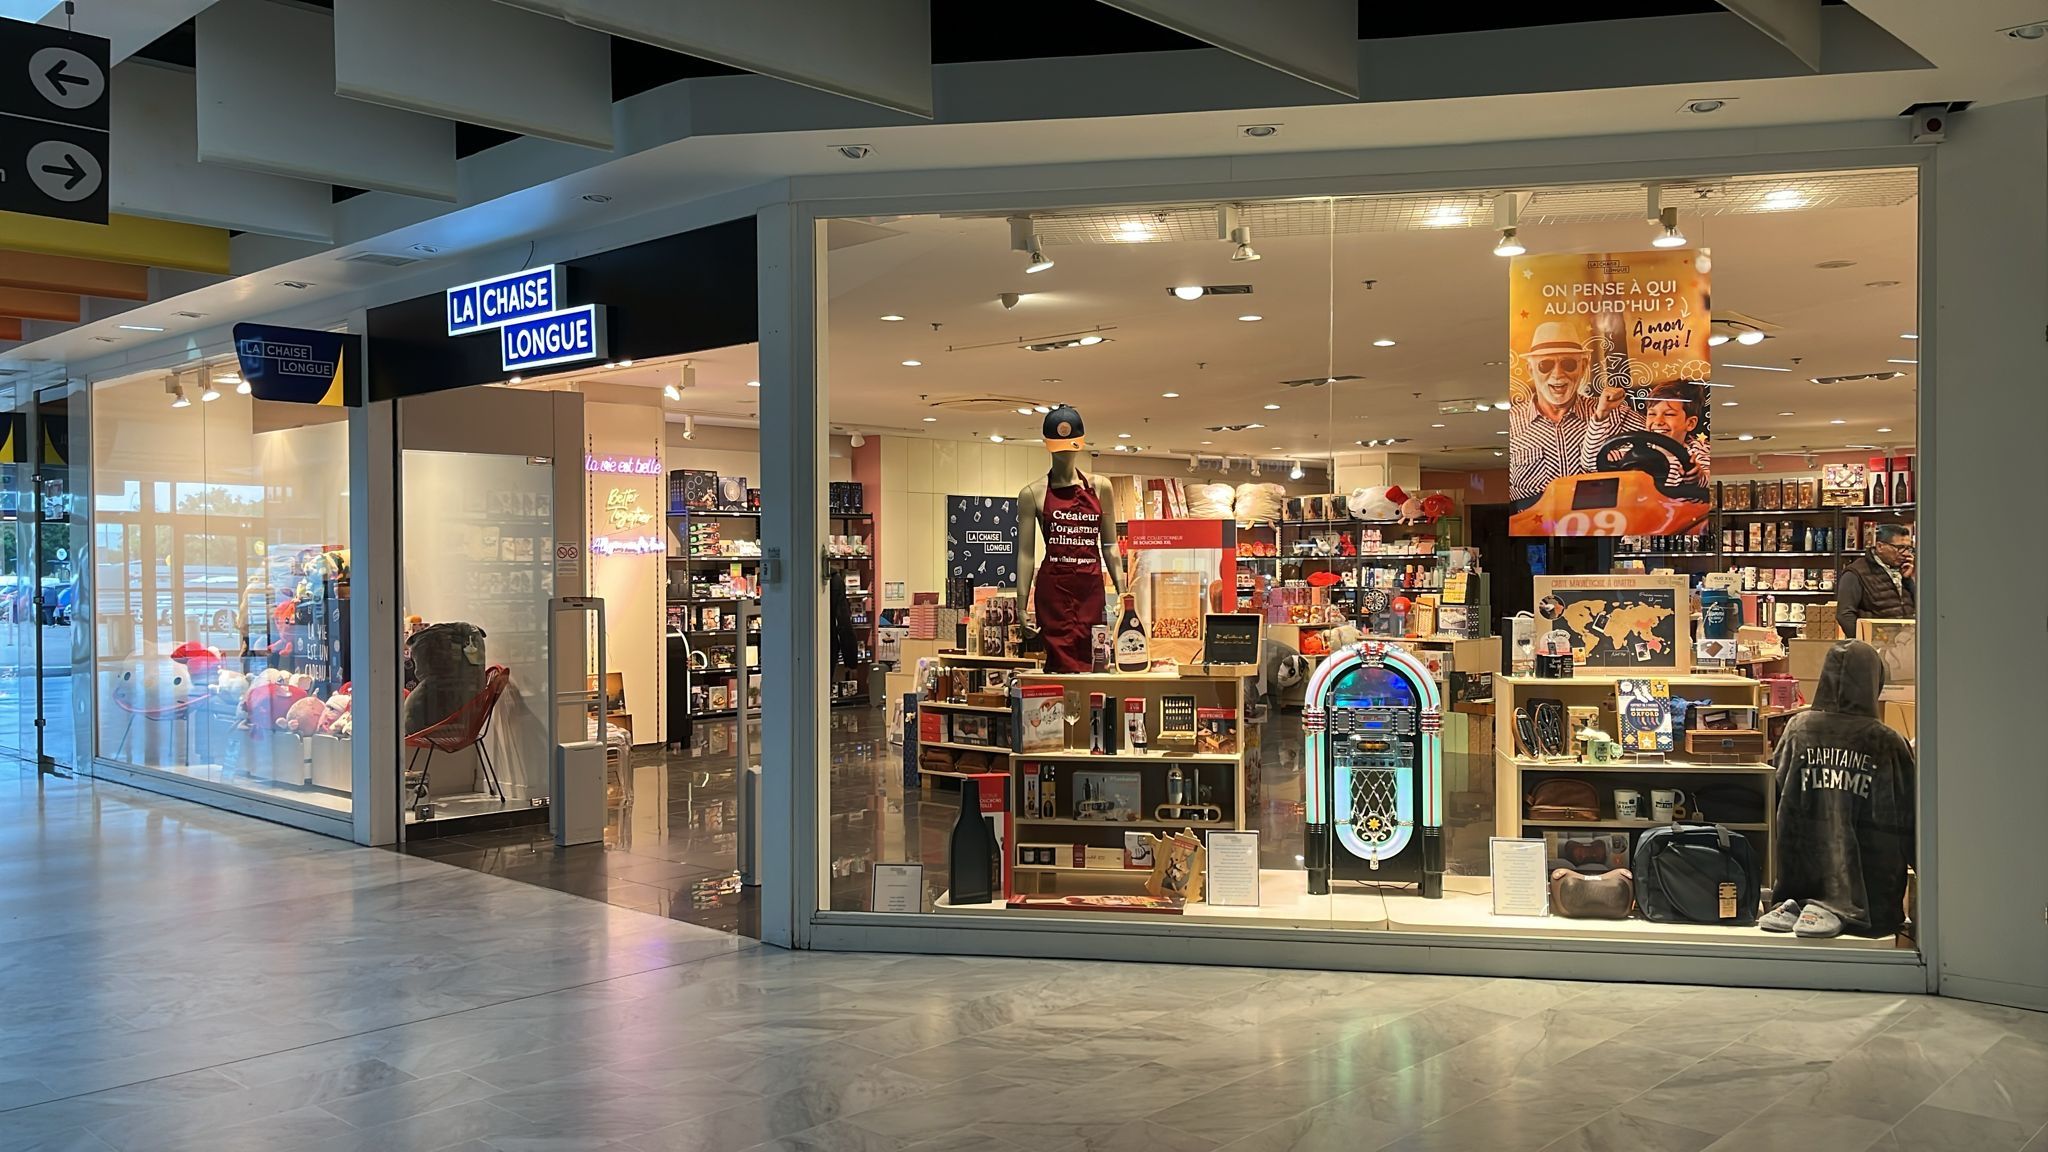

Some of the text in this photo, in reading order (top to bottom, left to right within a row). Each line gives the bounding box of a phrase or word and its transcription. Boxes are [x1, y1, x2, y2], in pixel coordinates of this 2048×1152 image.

[1543, 278, 1677, 297] ON PENSE À QUI
[453, 277, 548, 324] LA CHAISE
[1544, 298, 1674, 315] AUJOURD'HUI ?
[1633, 318, 1684, 337] À mon
[507, 318, 589, 360] LONGUE
[1640, 335, 1680, 356] Papi
[246, 343, 308, 358] LA CHAISE
[282, 361, 331, 375] LONGUE
[635, 457, 662, 475] belle
[1052, 510, 1099, 521] Créateur
[979, 533, 1000, 541] CHAISE
[1048, 535, 1095, 546] culinaires
[986, 544, 1011, 552] LONGUE
[308, 624, 328, 640] LA VIE
[307, 644, 329, 661] EST UN
[1806, 747, 1872, 772] CAPITAINE
[1801, 768, 1872, 799] FLEMME
